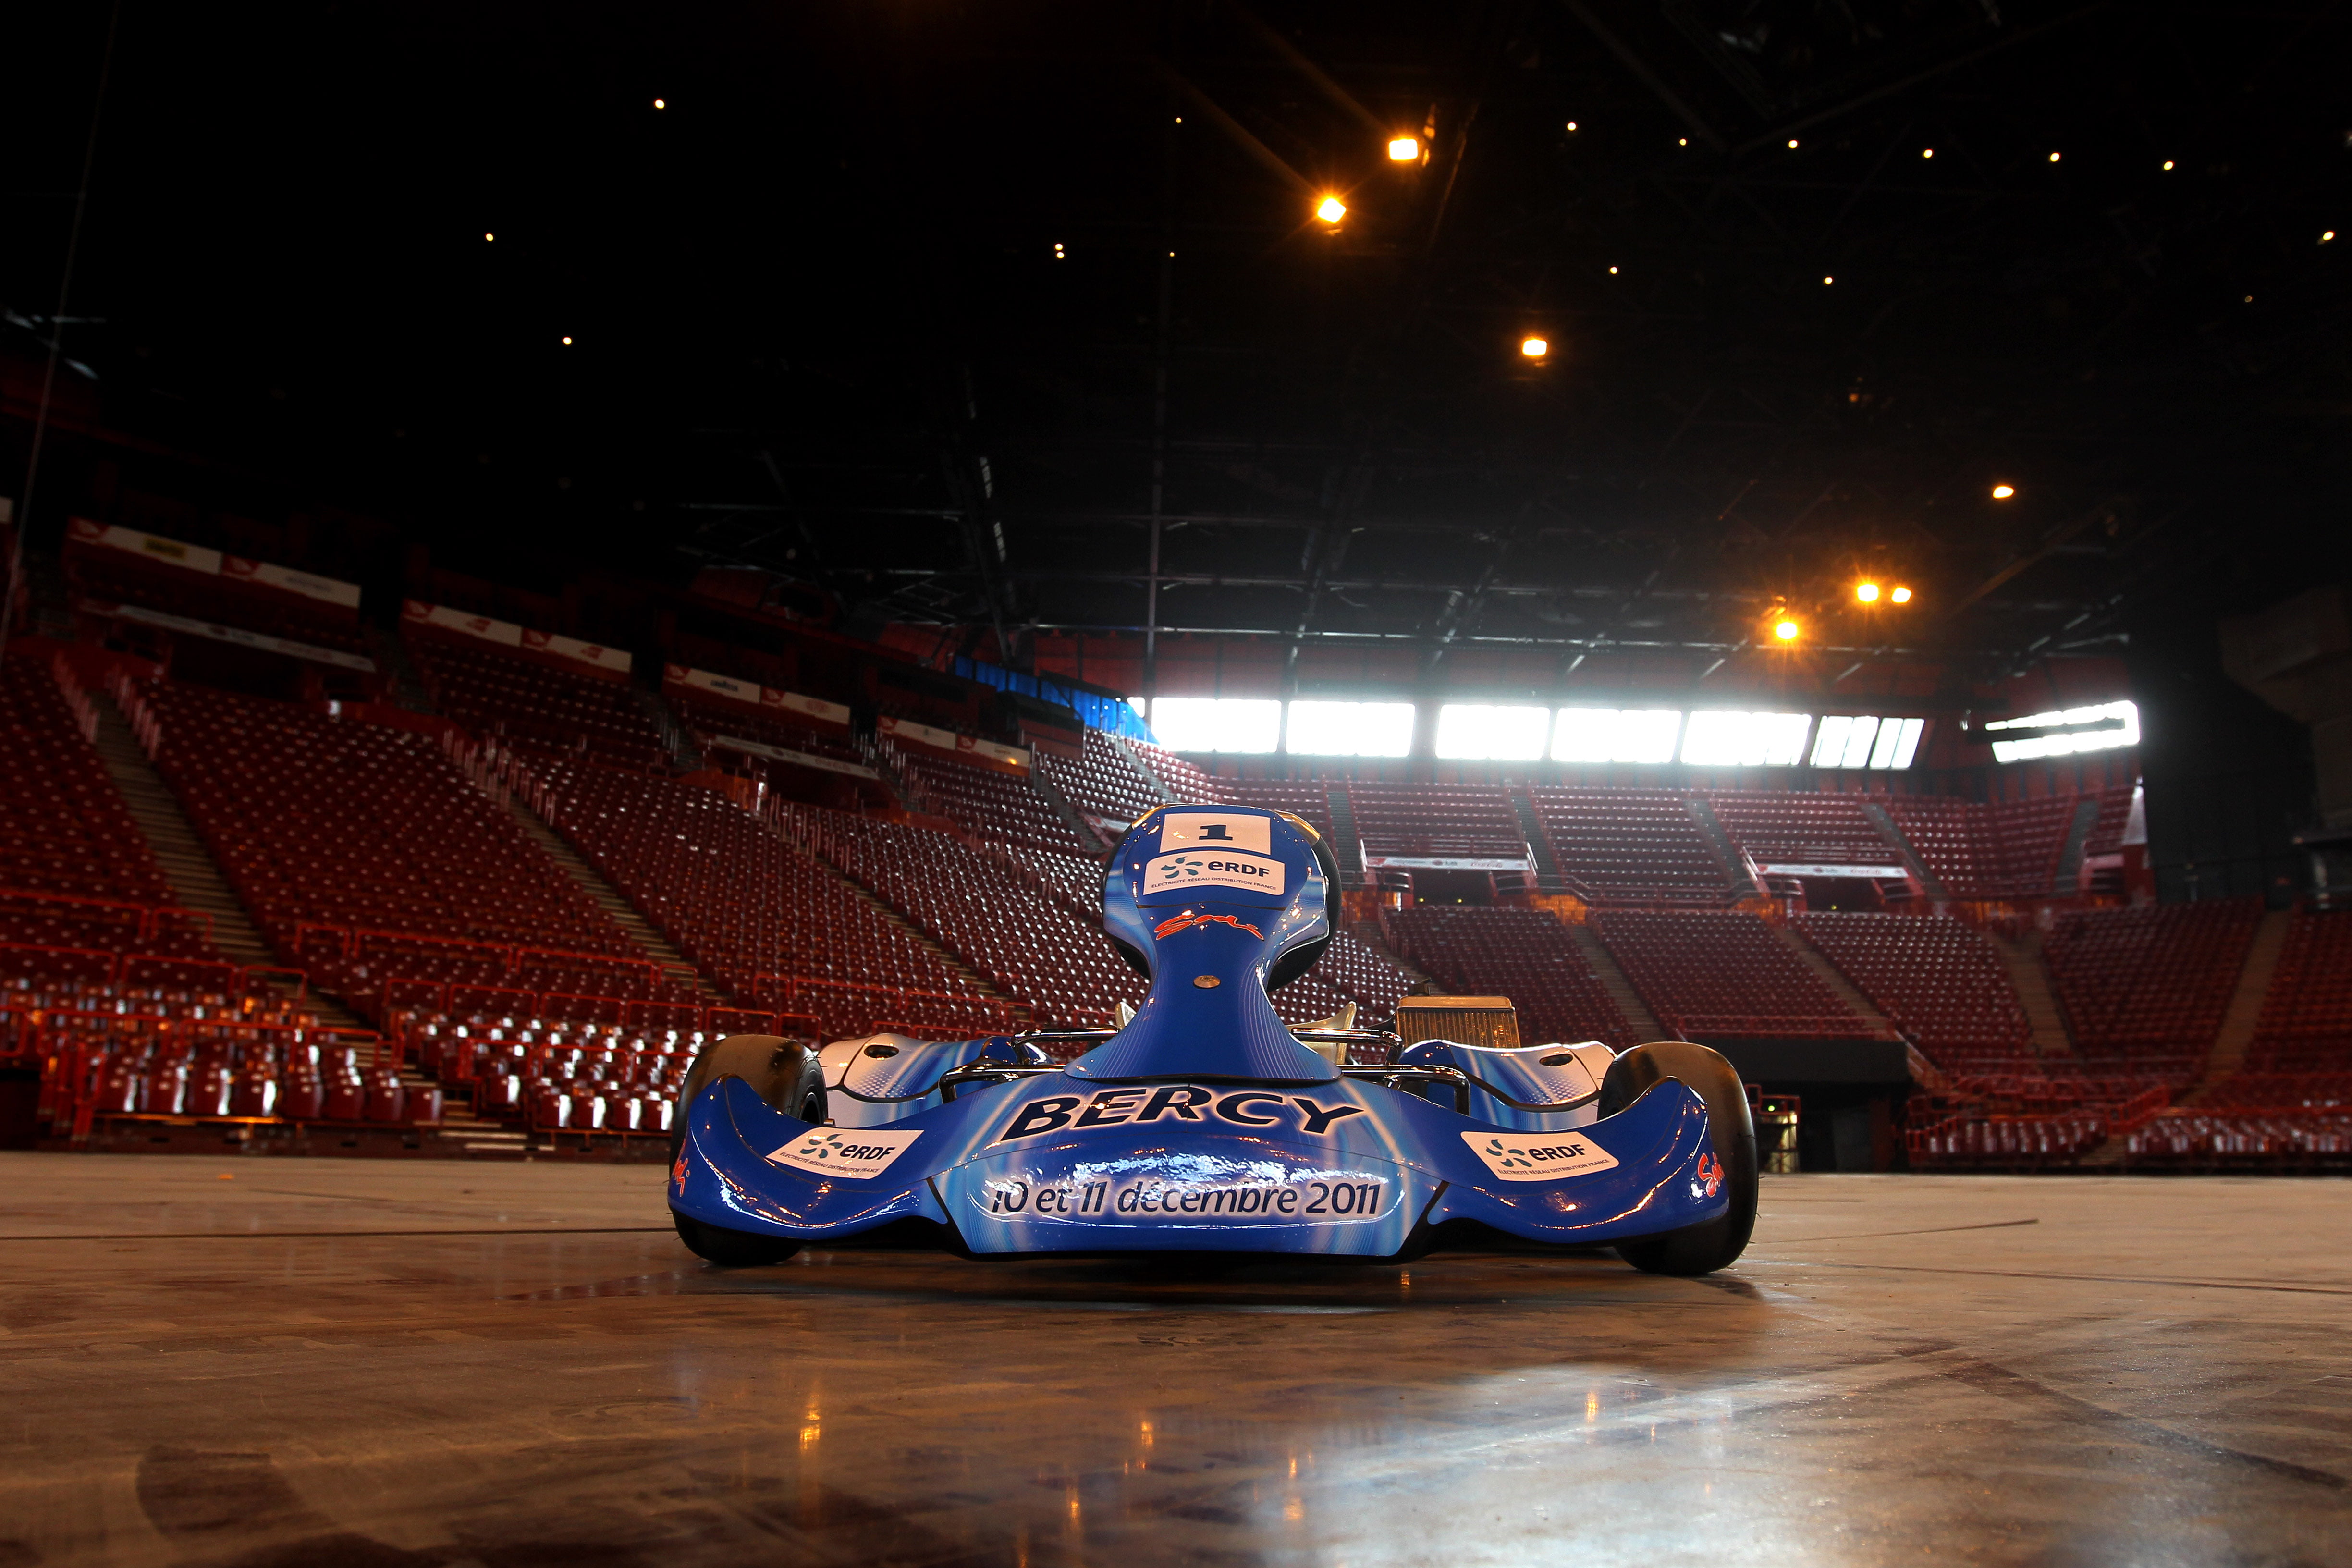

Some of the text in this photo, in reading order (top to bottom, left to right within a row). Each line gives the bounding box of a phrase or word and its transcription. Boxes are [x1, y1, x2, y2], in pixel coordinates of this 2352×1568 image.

[1199, 824, 1233, 840] 1
[1208, 861, 1270, 877] eRDF
[1211, 877, 1252, 885] DISTRIBUTION
[1253, 882, 1276, 891] FRANCE
[1001, 1086, 1364, 1141] BERCY
[840, 1145, 896, 1160] eRDF
[1528, 1144, 1585, 1161] eRDF
[1550, 1164, 1586, 1173] DISTRIBUTION
[1587, 1159, 1610, 1167] FRANCE
[1035, 1188, 1073, 1213] et
[1081, 1181, 1108, 1213] 11
[1117, 1181, 1297, 1213] décembre
[1306, 1182, 1382, 1214] 2011
